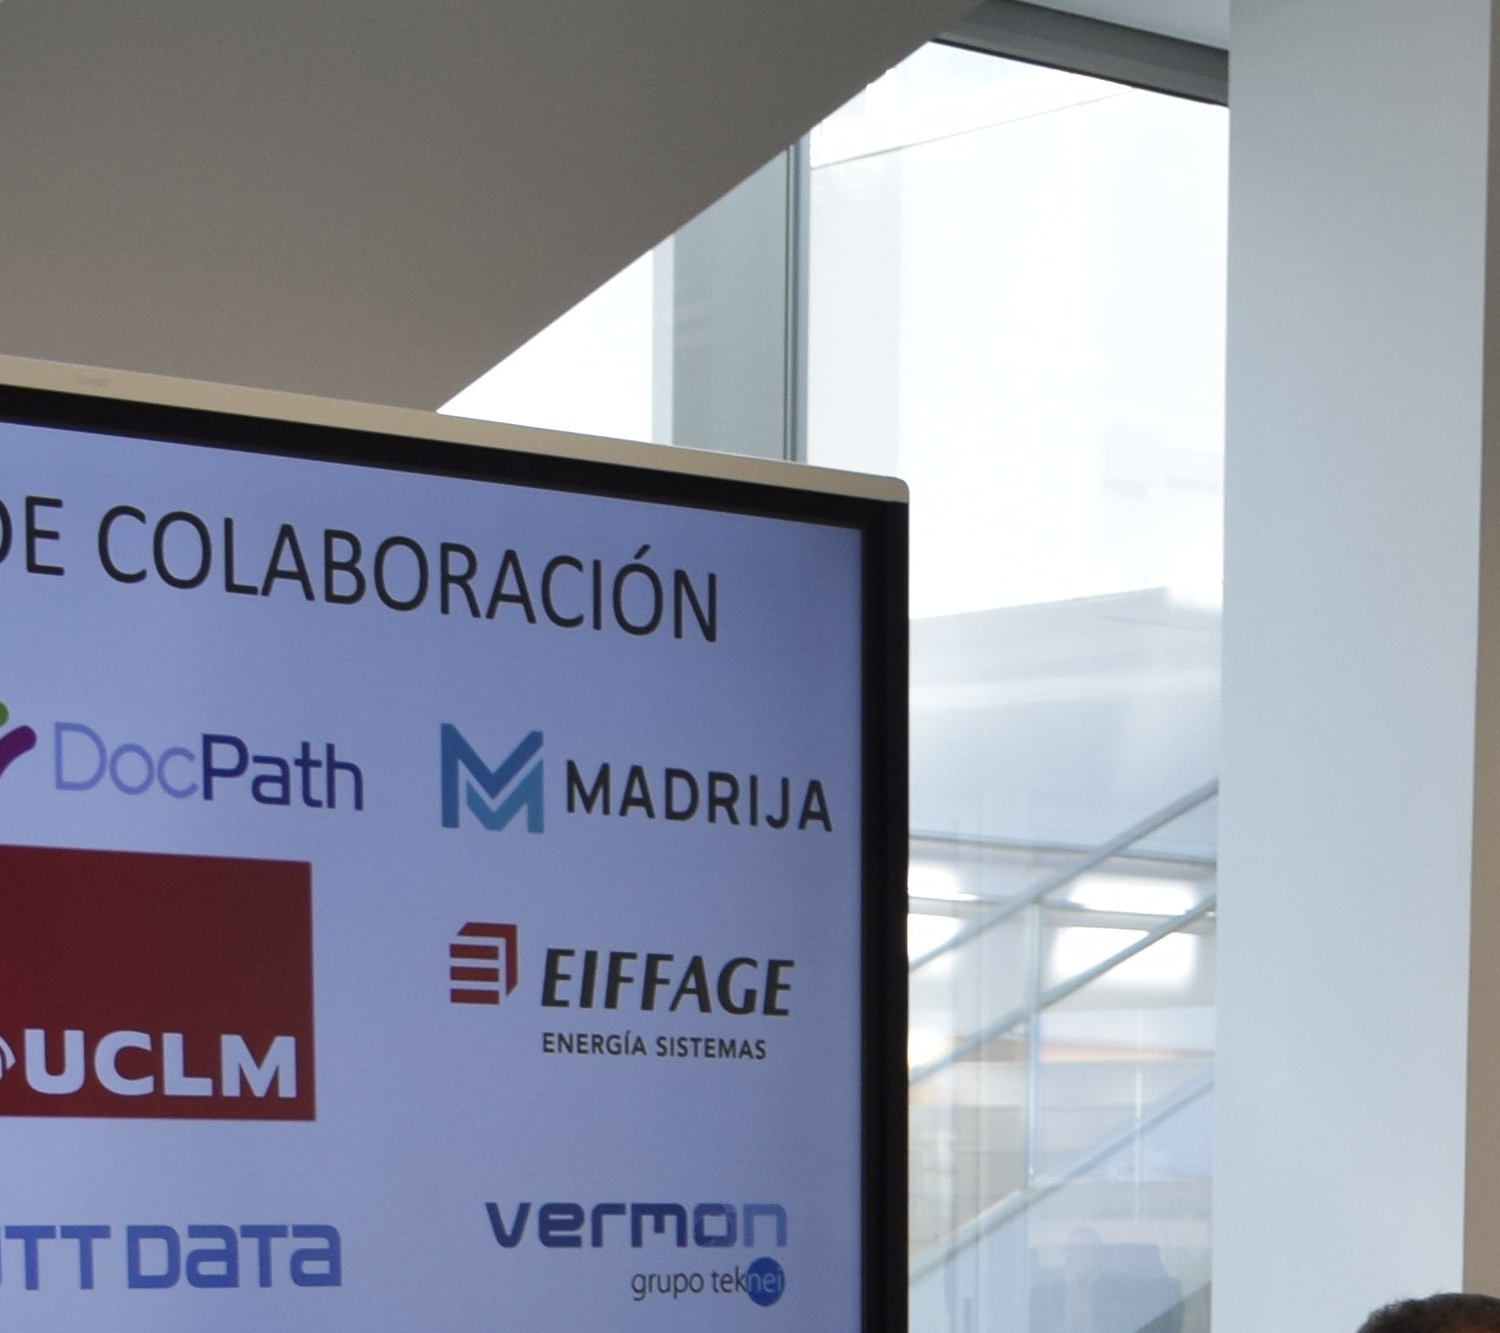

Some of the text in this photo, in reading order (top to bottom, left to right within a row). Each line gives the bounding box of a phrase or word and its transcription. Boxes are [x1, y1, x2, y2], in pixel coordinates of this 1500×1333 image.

[98, 505, 717, 643] COLABORACIÓN
[54, 721, 364, 811] DocPath
[566, 759, 833, 832] MADRIJA
[541, 948, 795, 1016] EIFFAGE
[23, 1028, 298, 1098] UCLM
[542, 1030, 767, 1060] ENERGÍA SISTEMAS
[484, 1202, 787, 1248] vermon
[631, 1266, 785, 1301] grupo teknei
